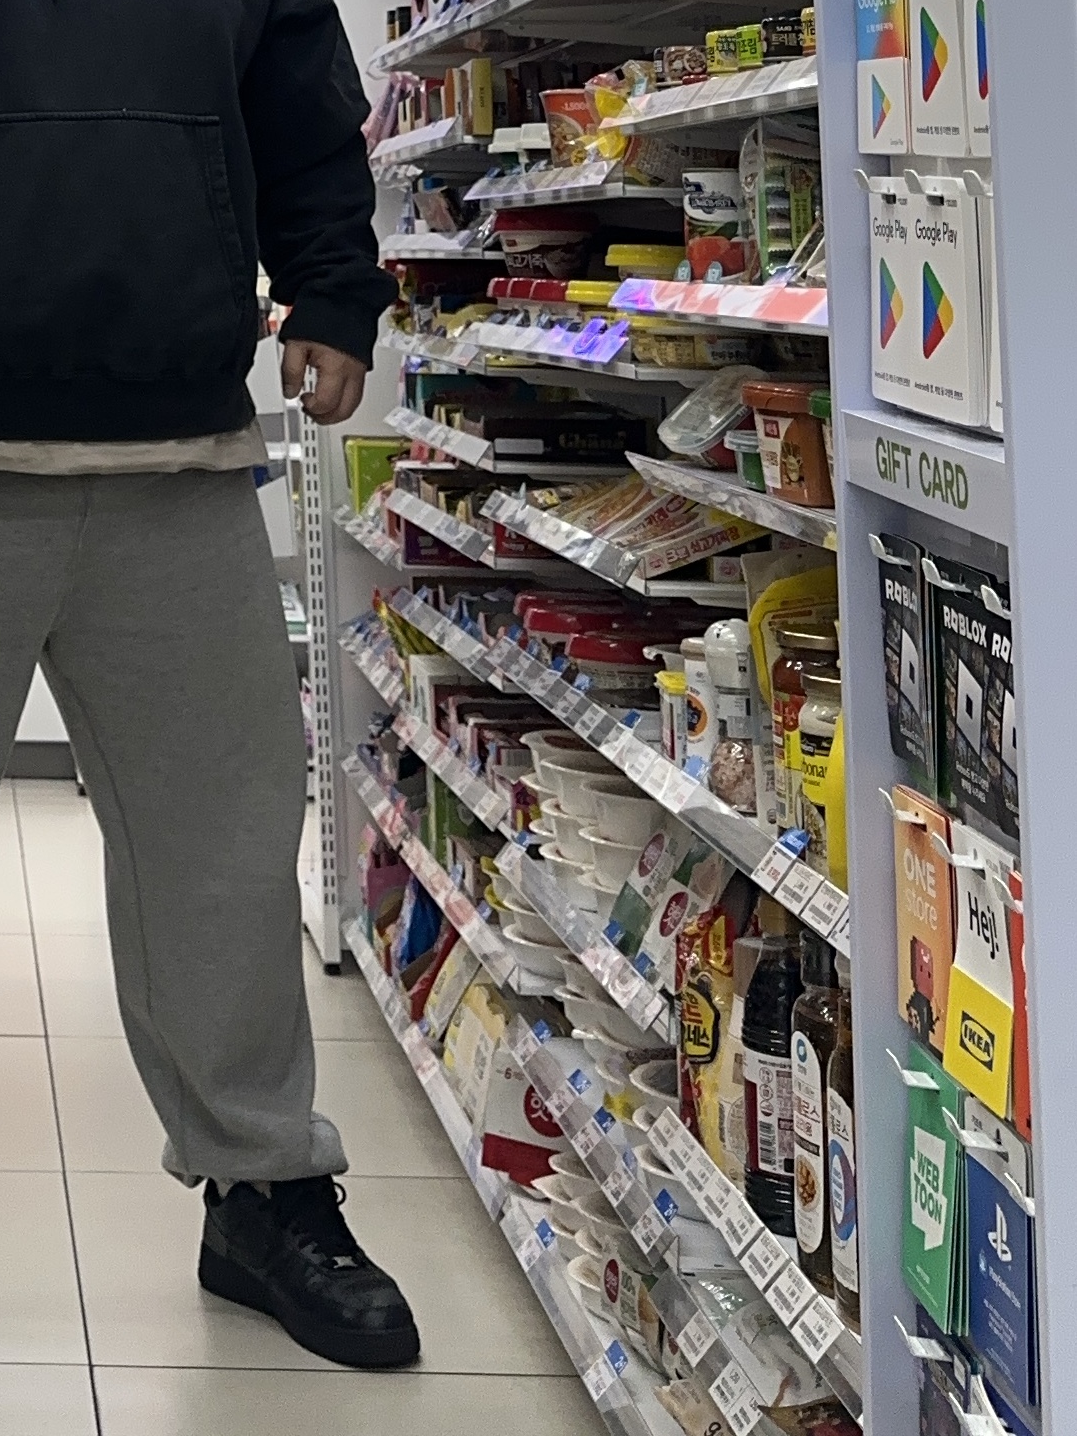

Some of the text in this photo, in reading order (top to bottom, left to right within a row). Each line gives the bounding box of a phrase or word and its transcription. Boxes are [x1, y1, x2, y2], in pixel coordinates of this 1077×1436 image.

[873, 216, 908, 246] Google Play
[915, 218, 958, 250] Google Play
[876, 435, 969, 511] GIFT CARD
[942, 605, 988, 649] ROBLOX
[903, 847, 937, 899] ONE
[905, 886, 939, 932] store
[967, 890, 1000, 960] Hej!
[963, 1023, 993, 1058] IKEA
[916, 1149, 940, 1194] WEB
[913, 1176, 943, 1226] TOON
